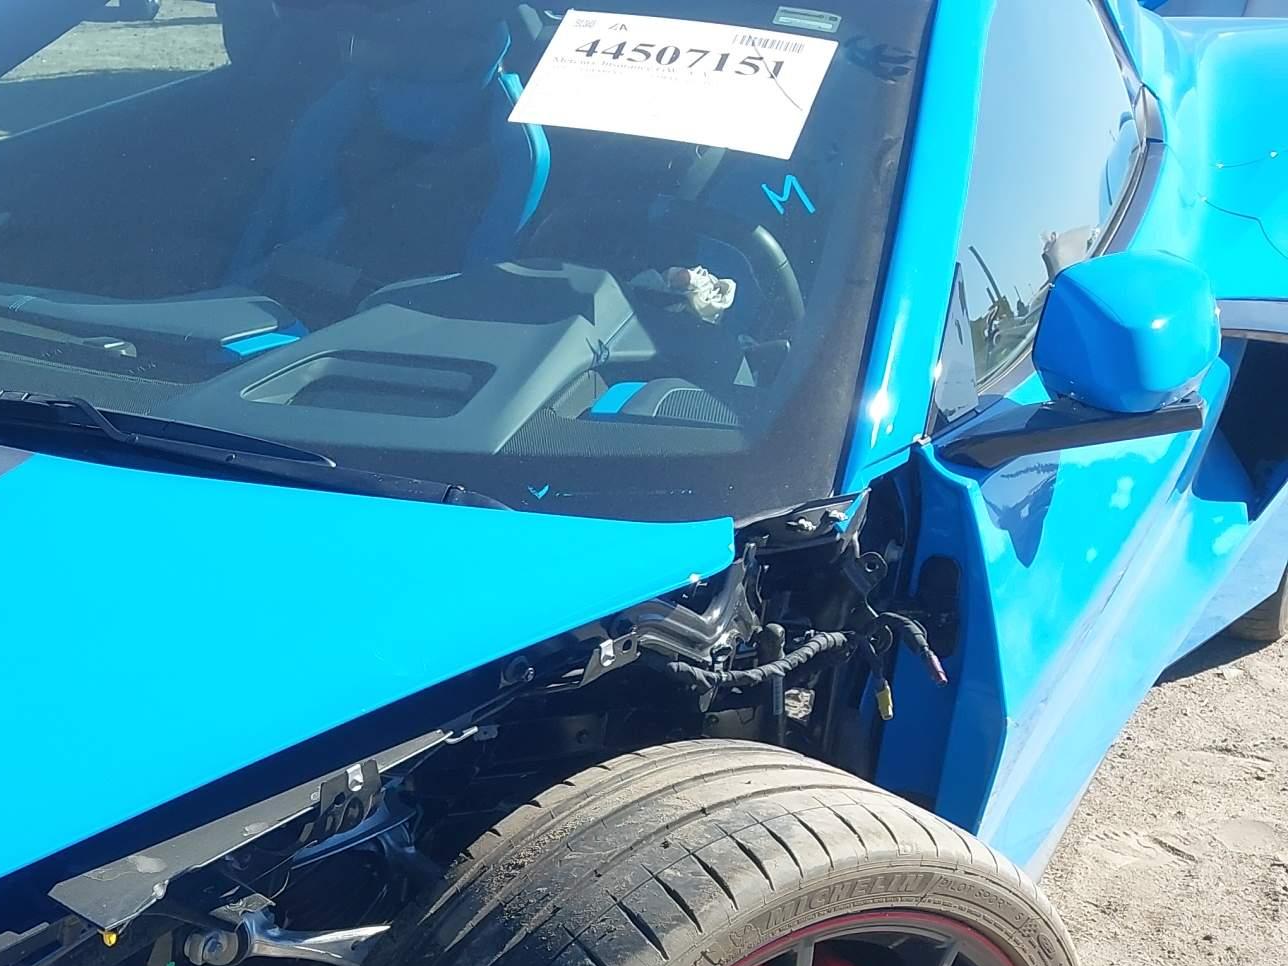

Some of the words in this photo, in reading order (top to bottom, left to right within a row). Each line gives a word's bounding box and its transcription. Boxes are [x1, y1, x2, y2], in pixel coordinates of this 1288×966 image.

[574, 38, 786, 80] 44507151
[761, 174, 816, 215] M
[766, 873, 925, 927] MICHELIN
[939, 876, 975, 893] PILOT
[975, 888, 1012, 909] SPORT
